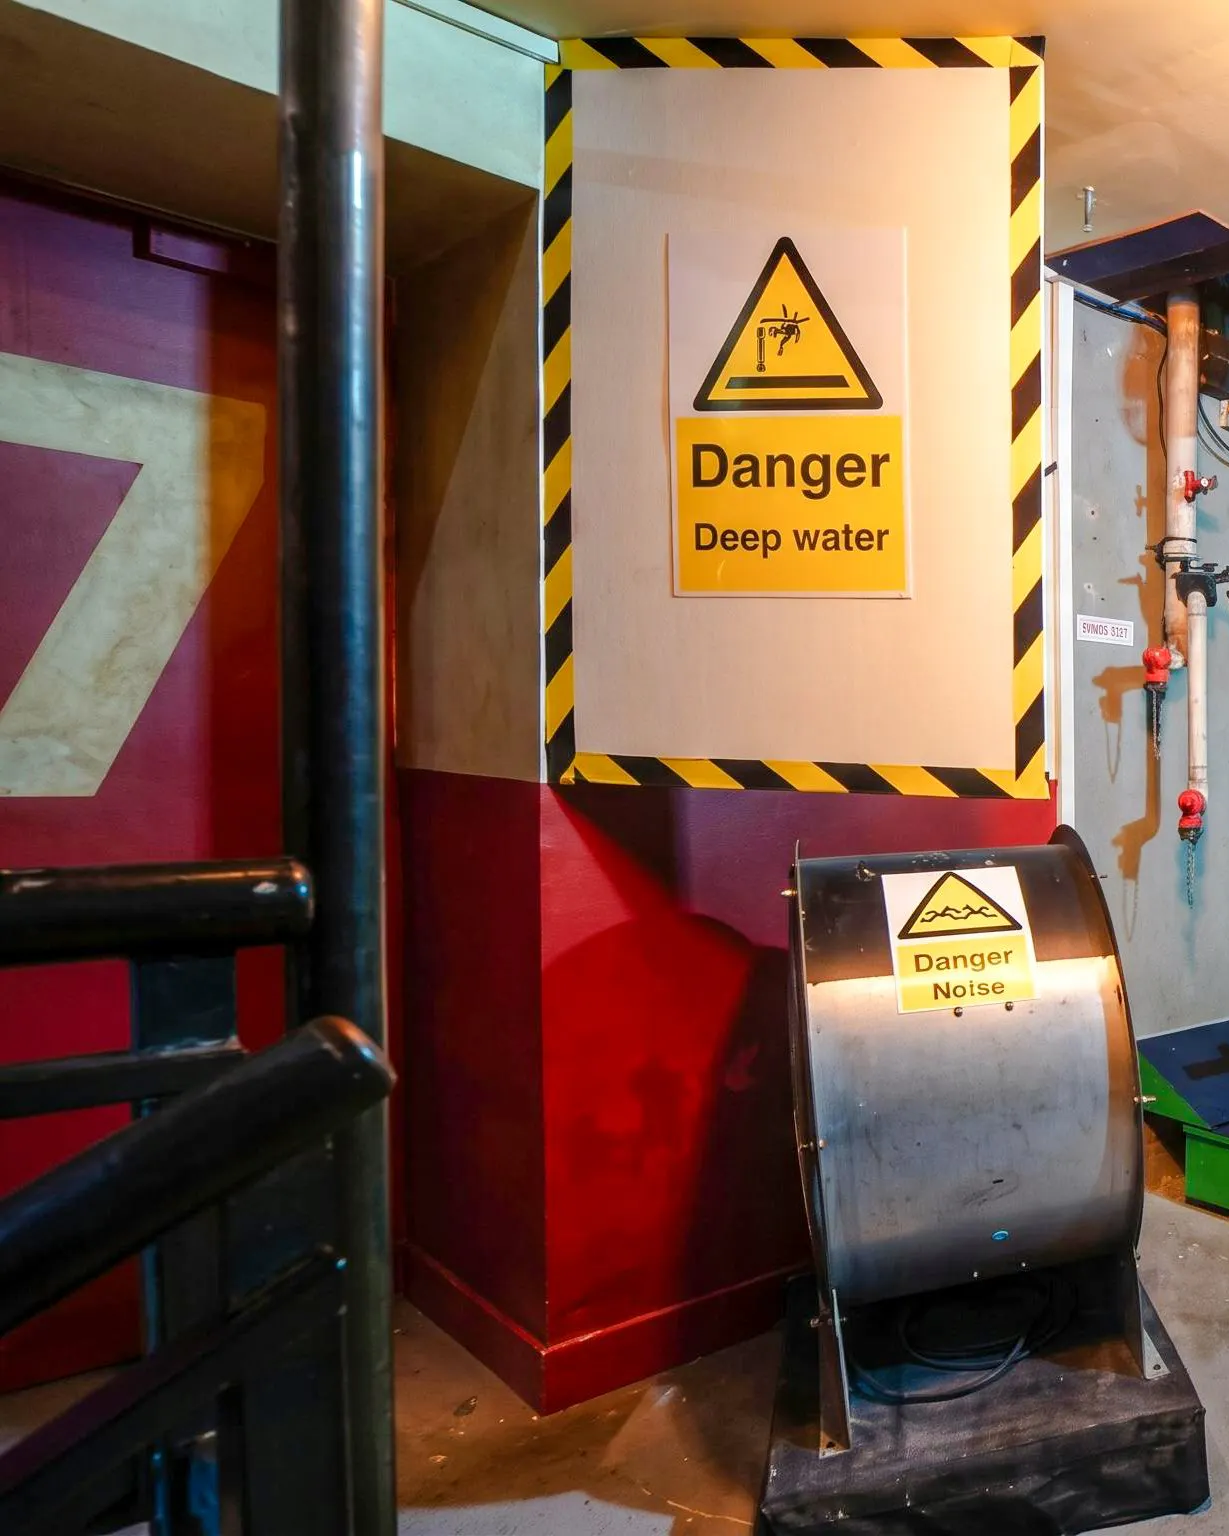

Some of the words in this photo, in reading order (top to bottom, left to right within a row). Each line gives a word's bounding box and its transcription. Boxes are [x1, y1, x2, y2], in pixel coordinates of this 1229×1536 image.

[691, 443, 890, 500] Danger
[694, 523, 782, 558] Deep
[793, 523, 889, 552] water
[913, 949, 1013, 972] Danger
[933, 980, 1005, 1000] Noise
